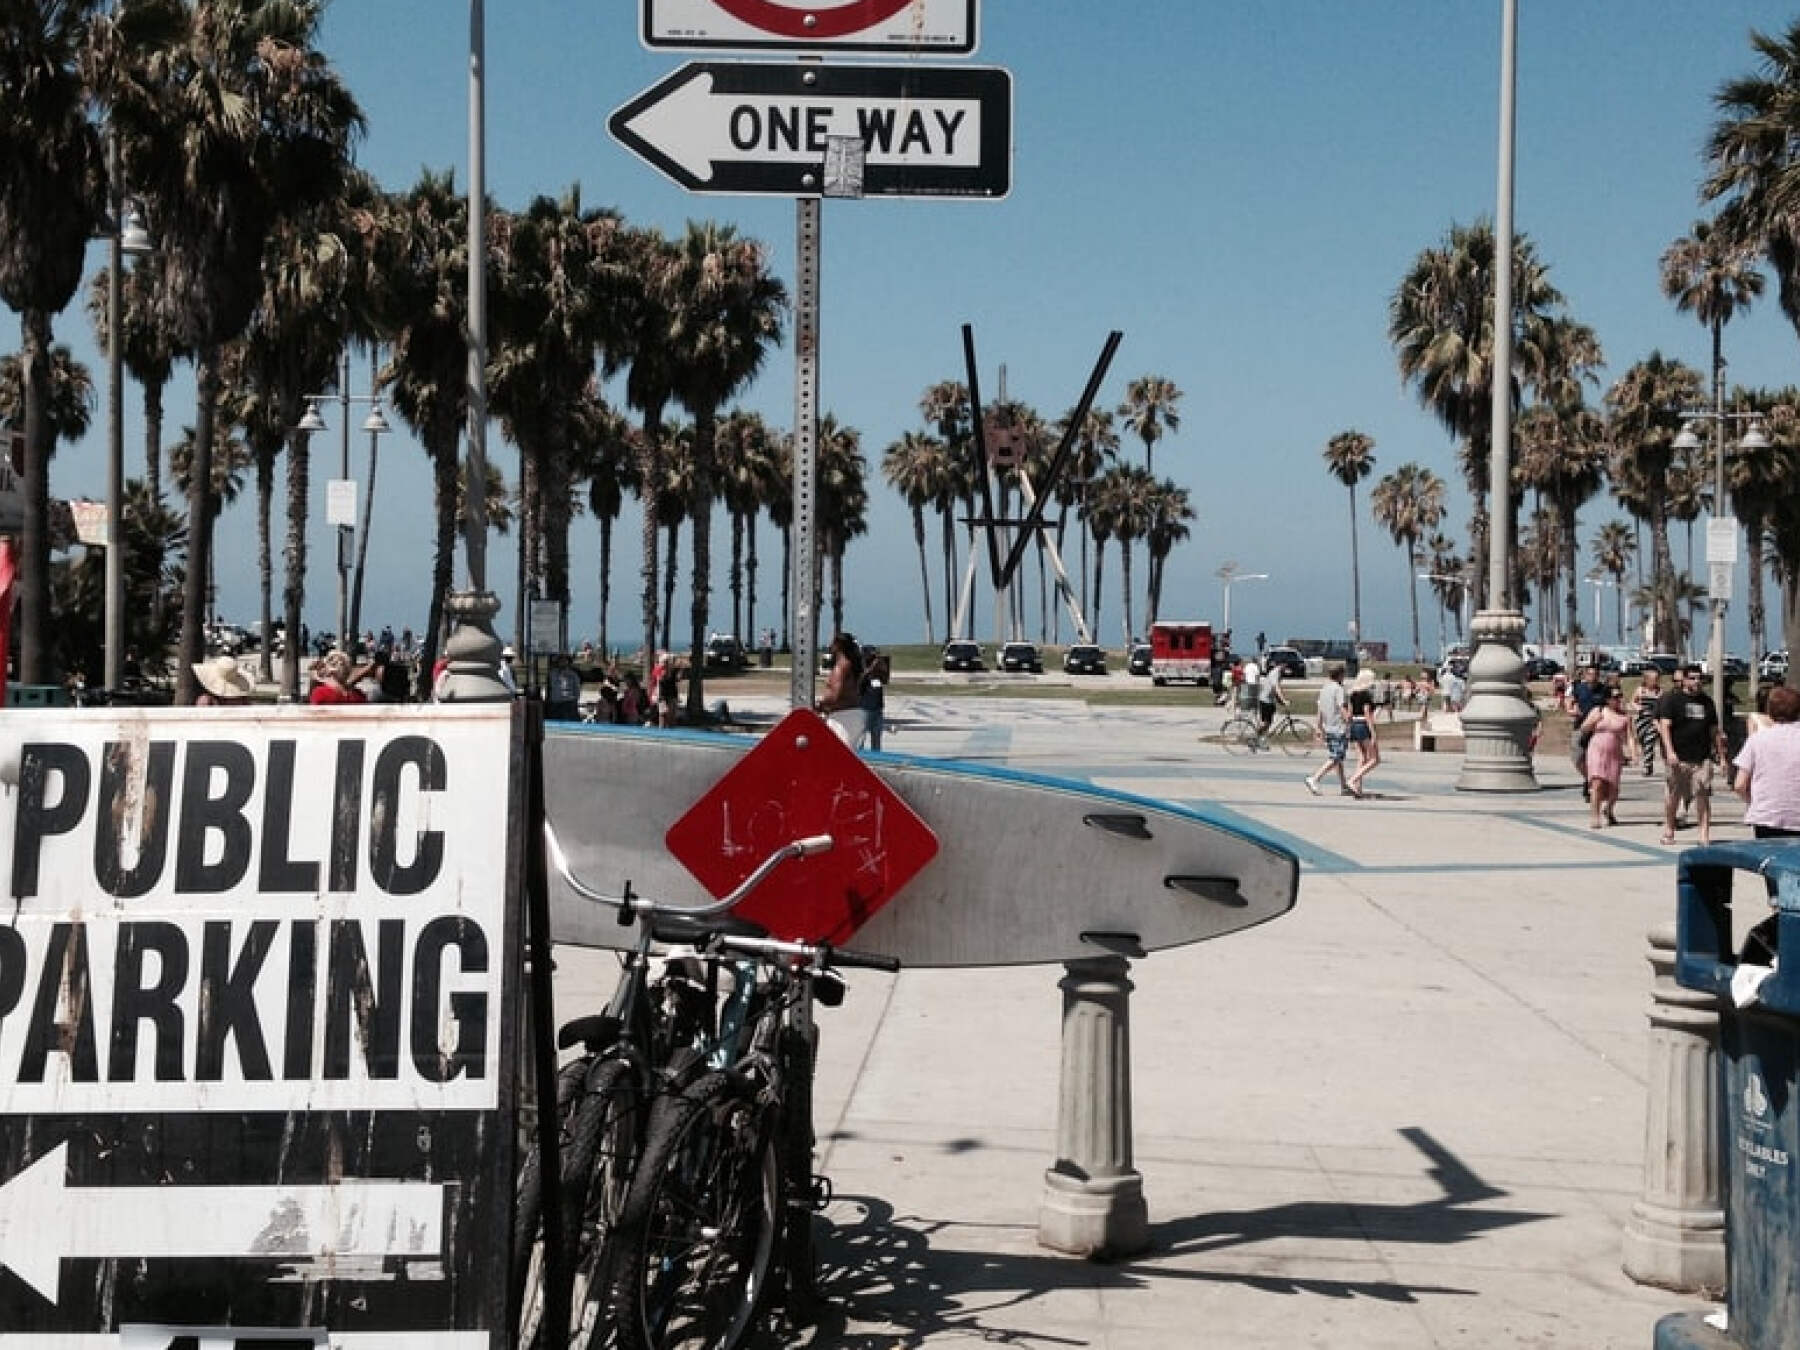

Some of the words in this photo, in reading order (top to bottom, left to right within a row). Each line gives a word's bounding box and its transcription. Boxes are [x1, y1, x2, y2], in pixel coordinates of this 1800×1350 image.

[729, 104, 834, 152] ONE
[856, 107, 967, 155] WAY
[11, 734, 448, 899] PUBLIC
